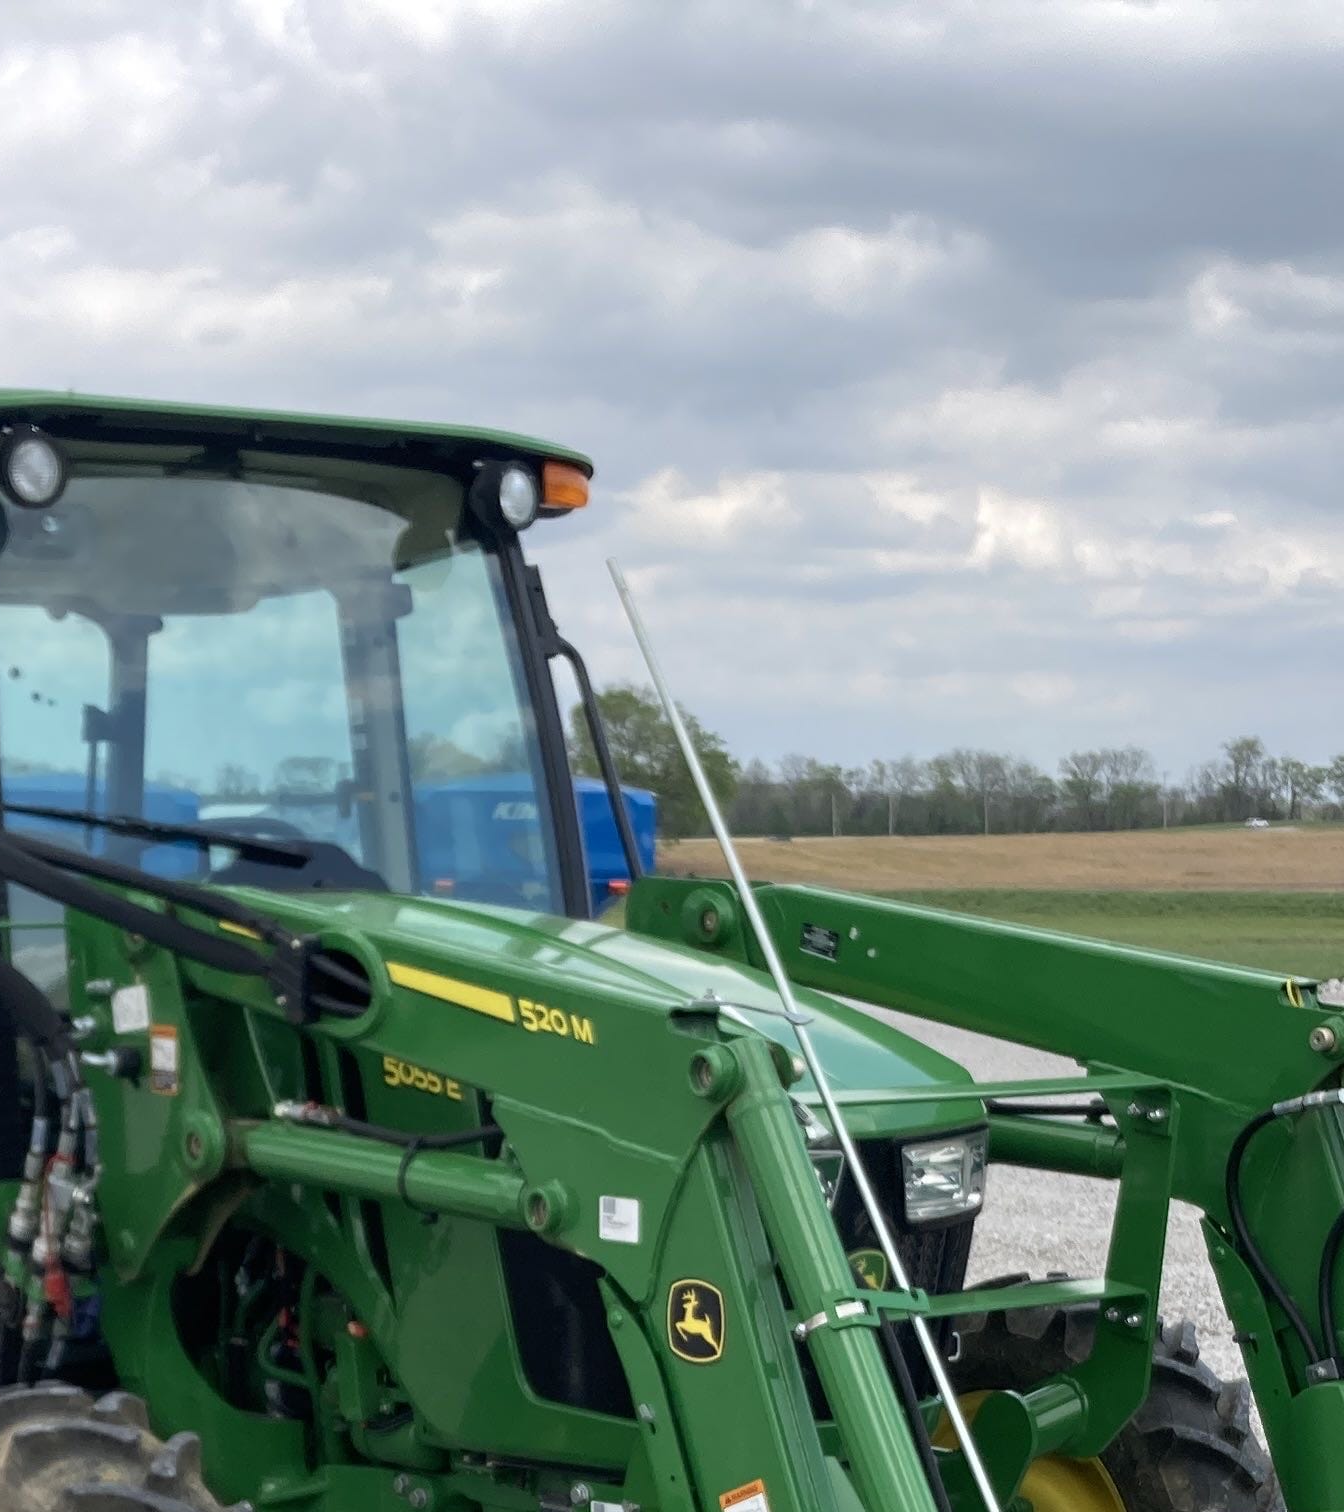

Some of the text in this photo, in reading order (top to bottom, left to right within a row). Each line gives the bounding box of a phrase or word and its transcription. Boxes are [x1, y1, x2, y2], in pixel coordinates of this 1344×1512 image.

[518, 999, 594, 1044] 520 M
[383, 1056, 462, 1100] 5055 E
